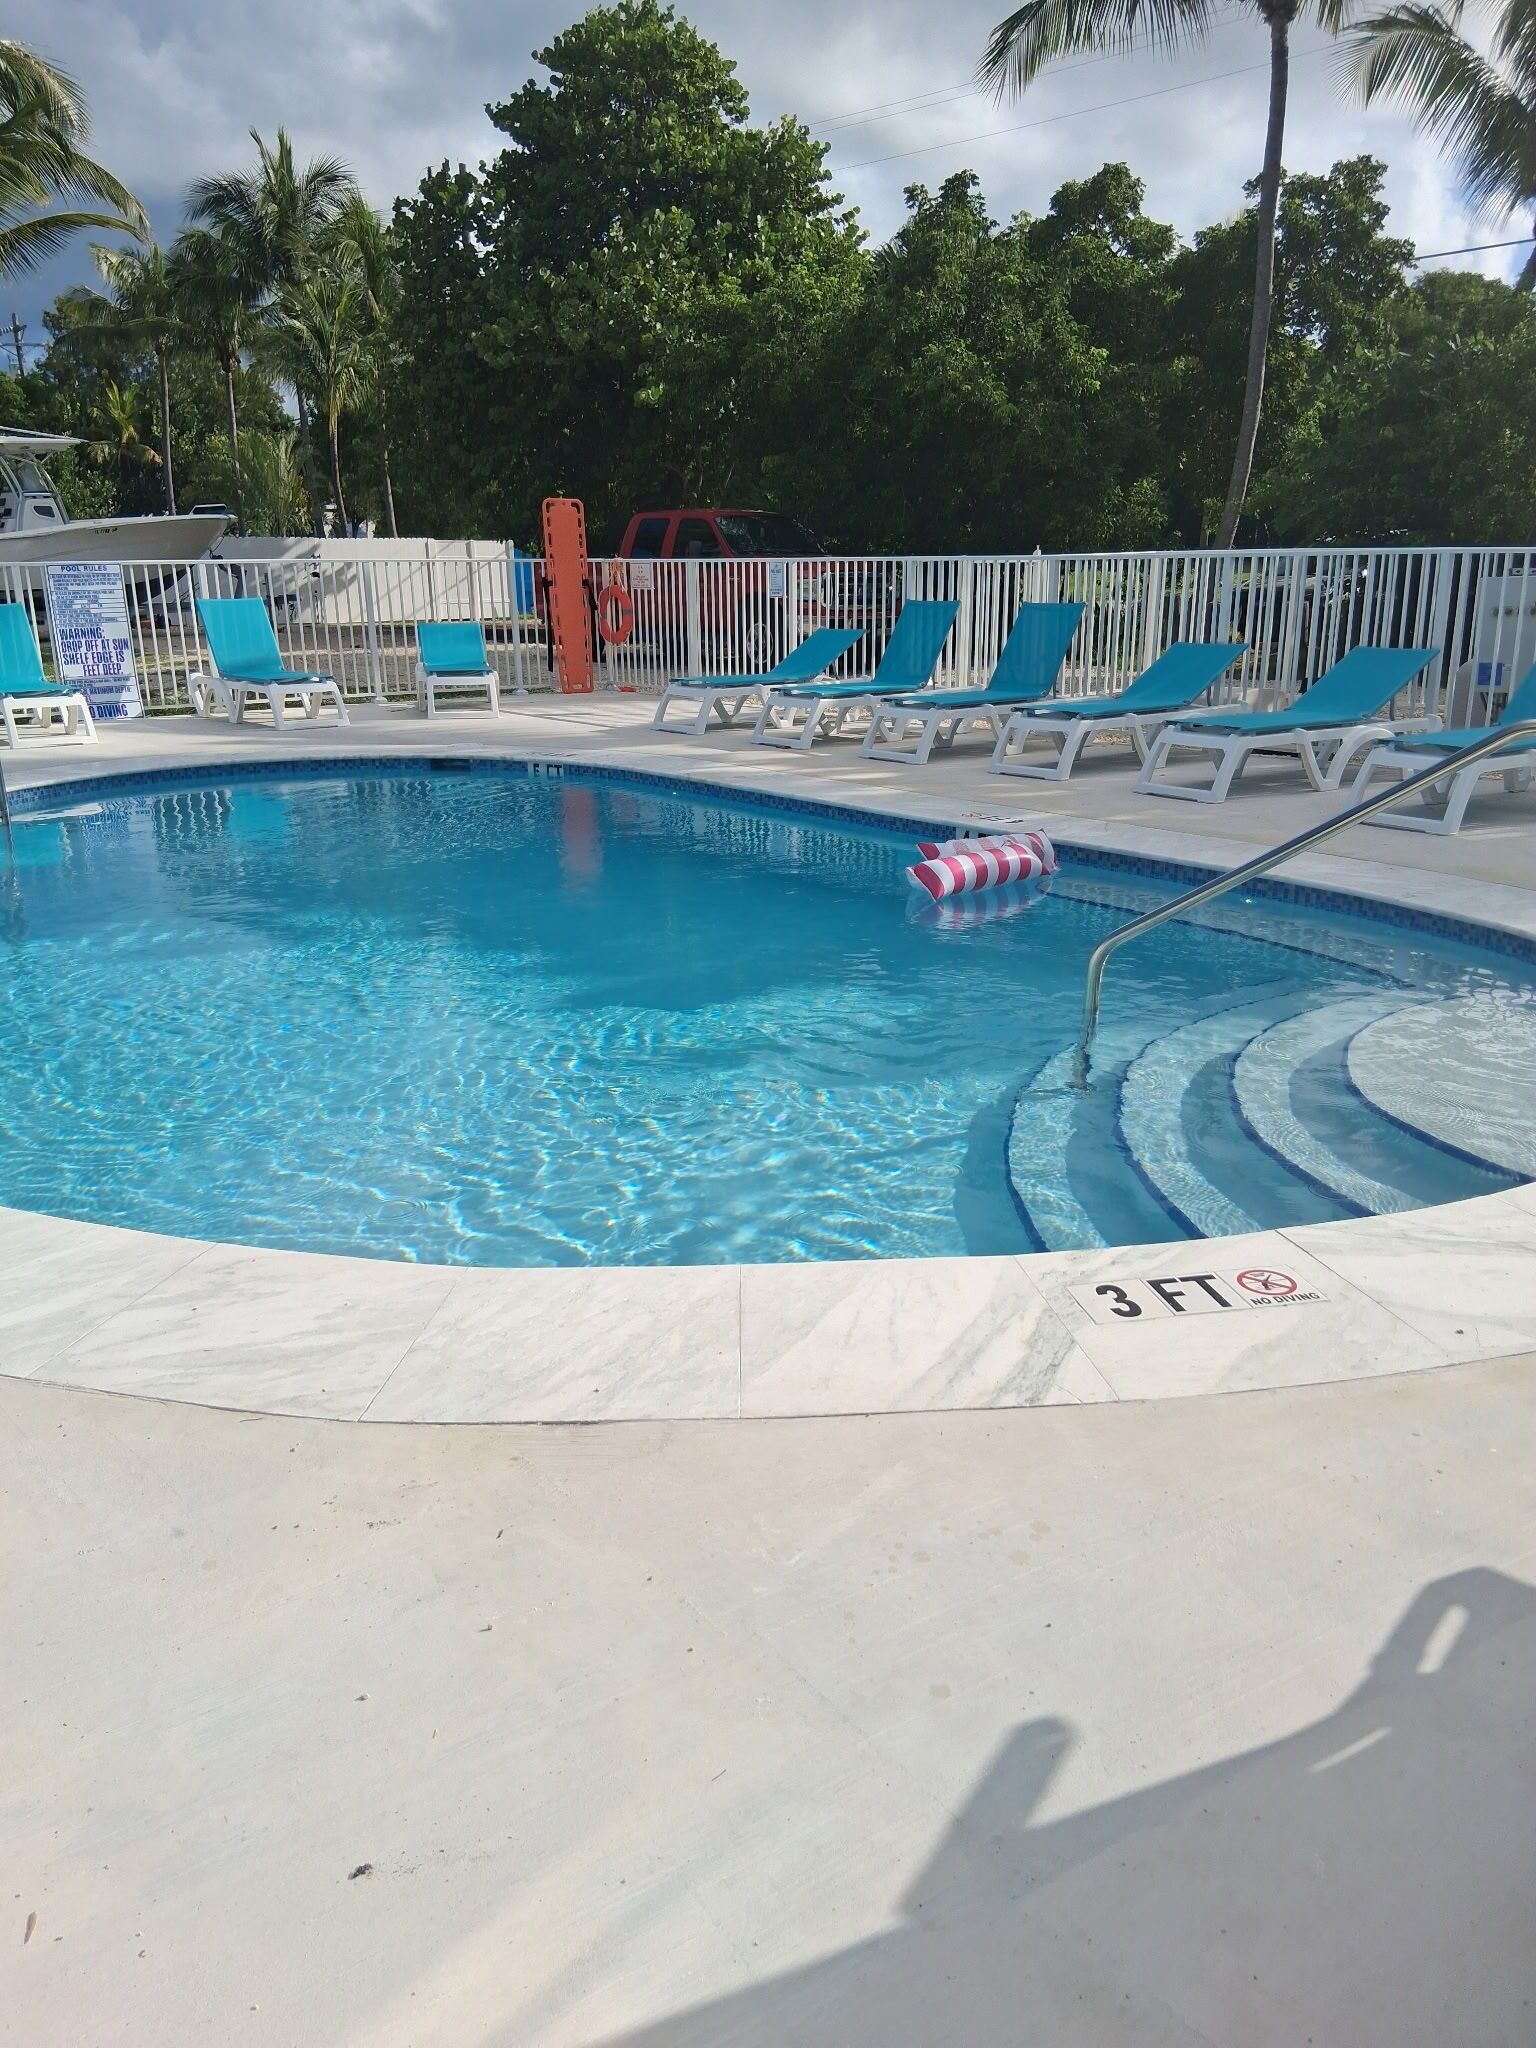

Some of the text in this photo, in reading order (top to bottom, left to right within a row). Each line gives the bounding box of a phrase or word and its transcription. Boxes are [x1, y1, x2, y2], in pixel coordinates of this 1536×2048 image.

[59, 627, 105, 640] WARNING:
[61, 638, 129, 653] DROP OFF AT SUN
[62, 650, 125, 665] SHELF EDGE IS
[82, 663, 124, 677] FEET DEEP.
[96, 703, 128, 718] DIVING
[1095, 1275, 1232, 1317] 3 FT
[1250, 1292, 1320, 1306] NO DIVING
